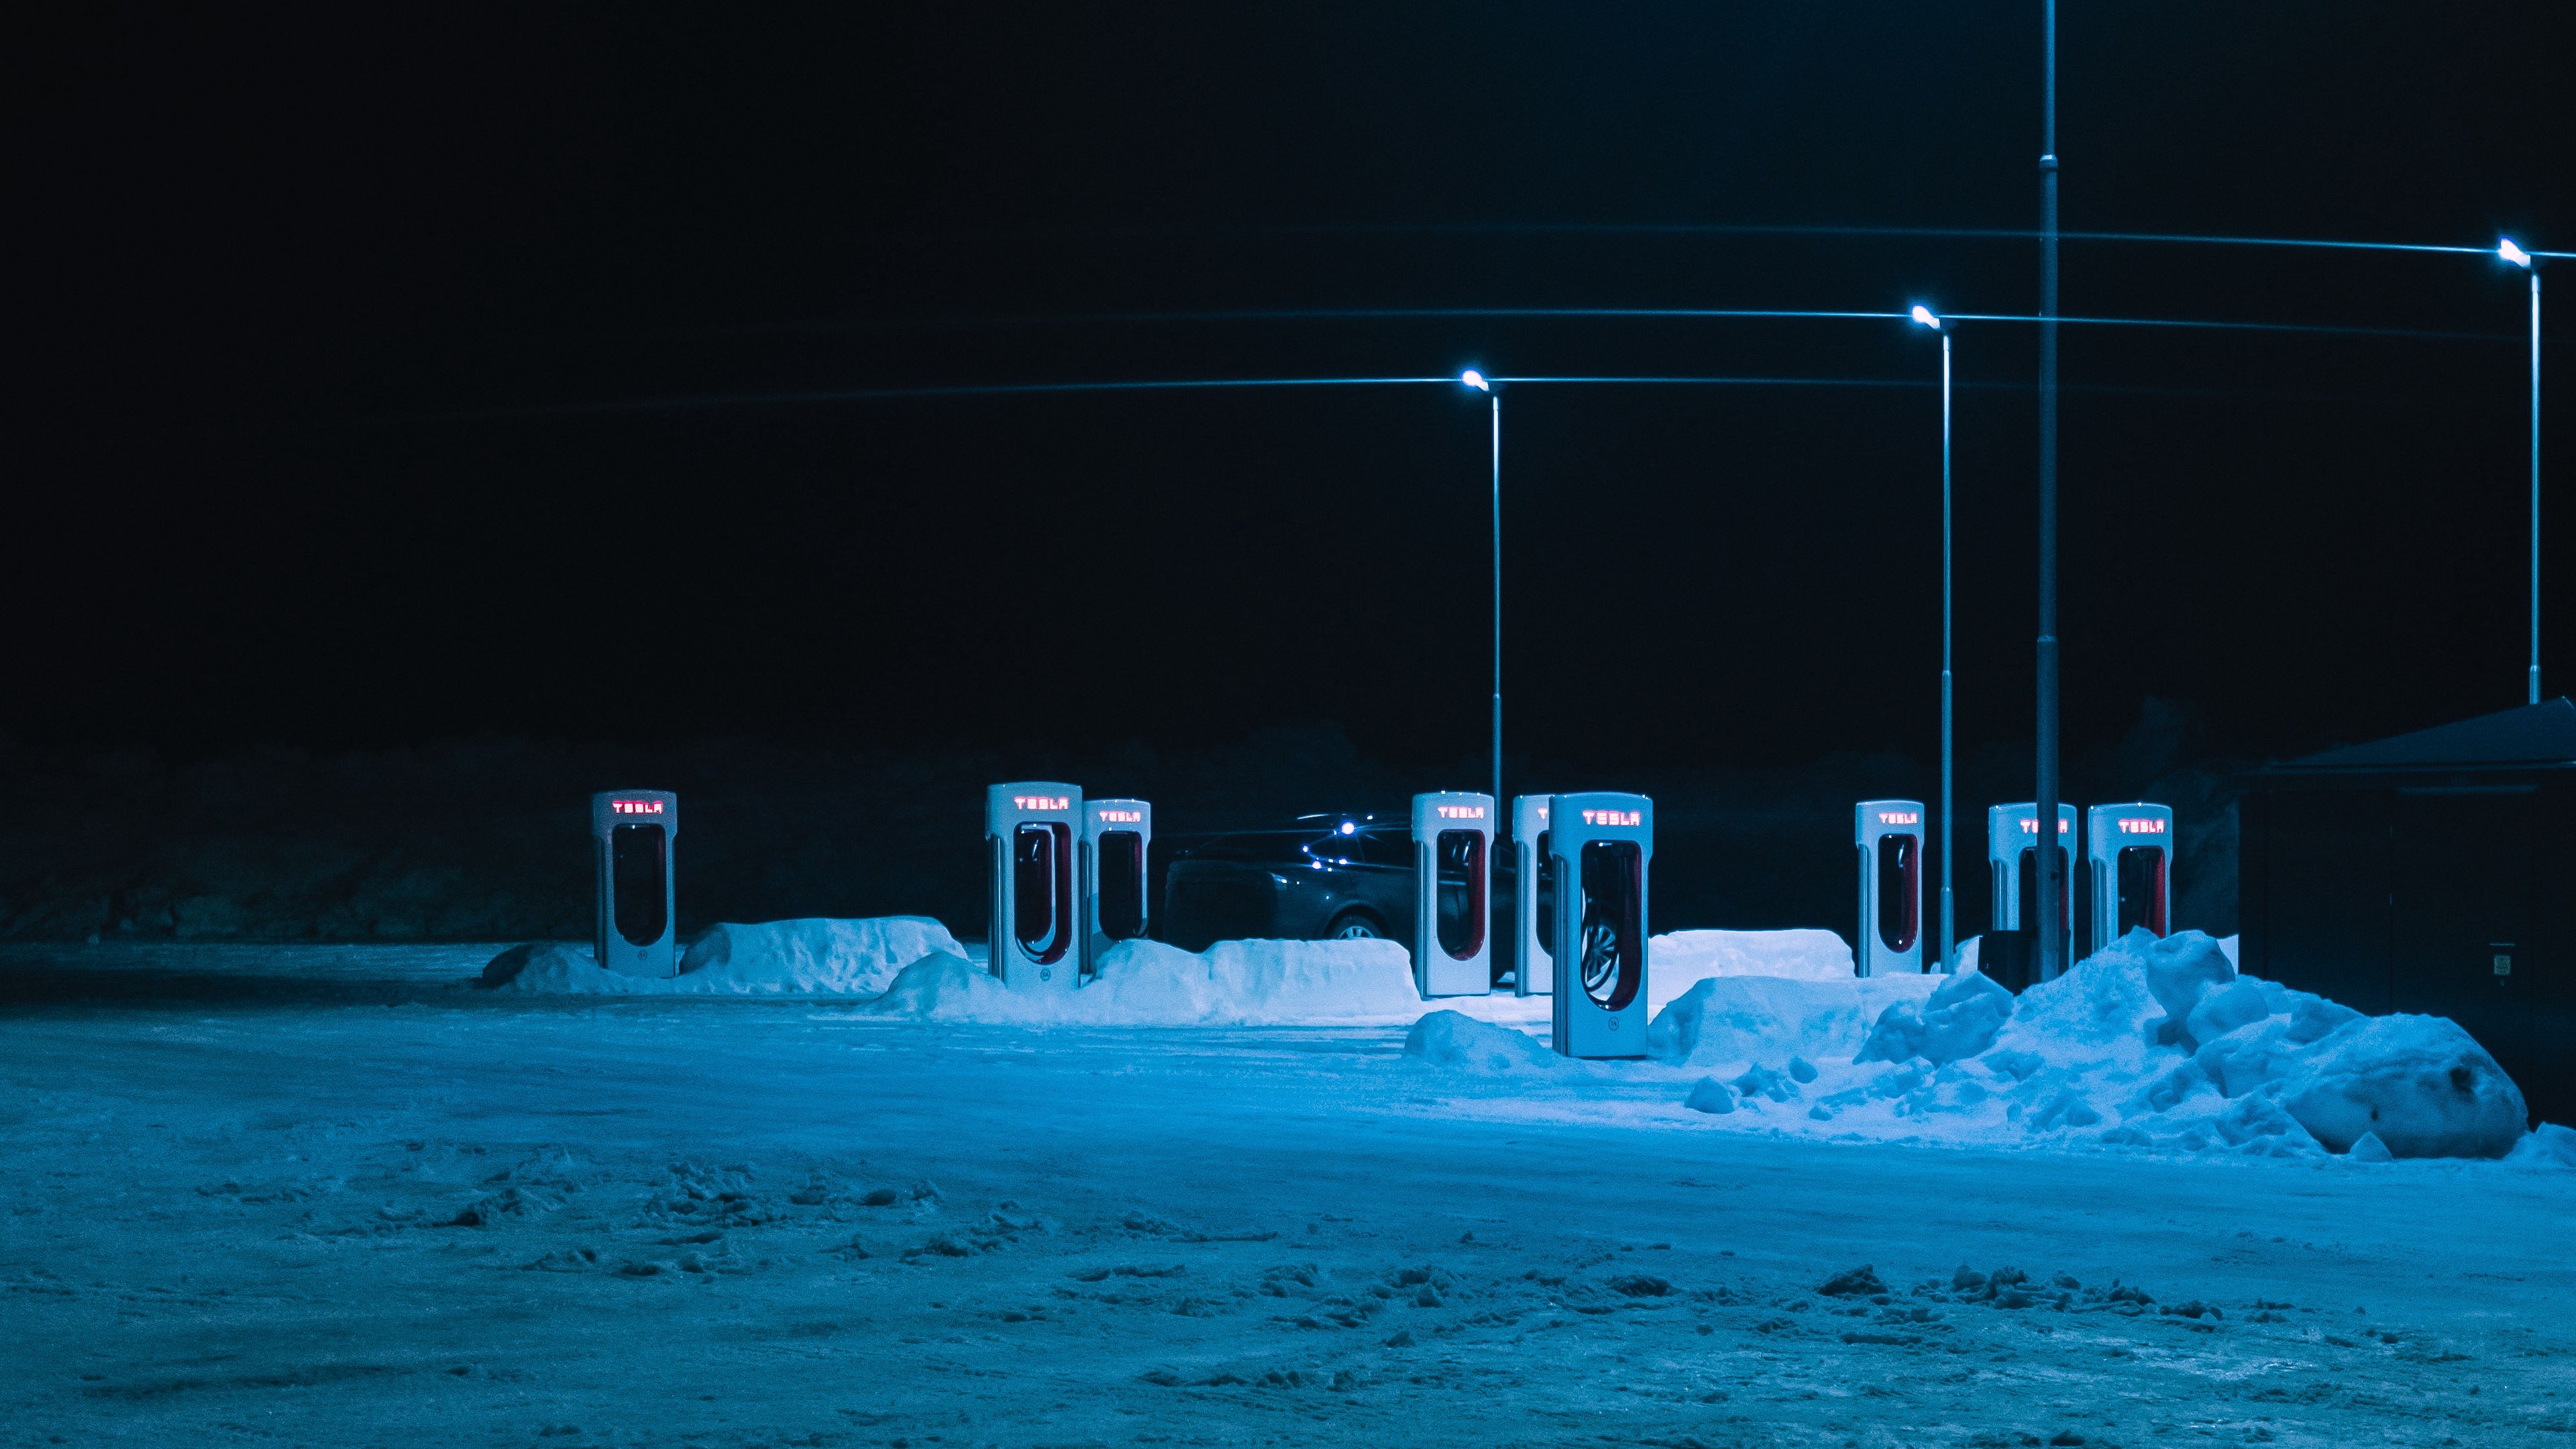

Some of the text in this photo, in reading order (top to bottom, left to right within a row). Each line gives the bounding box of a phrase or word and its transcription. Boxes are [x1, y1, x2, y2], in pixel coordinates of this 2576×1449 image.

[612, 800, 664, 815] TESLA
[1014, 796, 1069, 811] TESLA
[1100, 810, 1140, 822] TESLA
[1438, 806, 1485, 818] TESLA
[1582, 810, 1640, 826] TESLA
[1878, 812, 1917, 824] TESLA
[2118, 819, 2165, 834] TESLA
